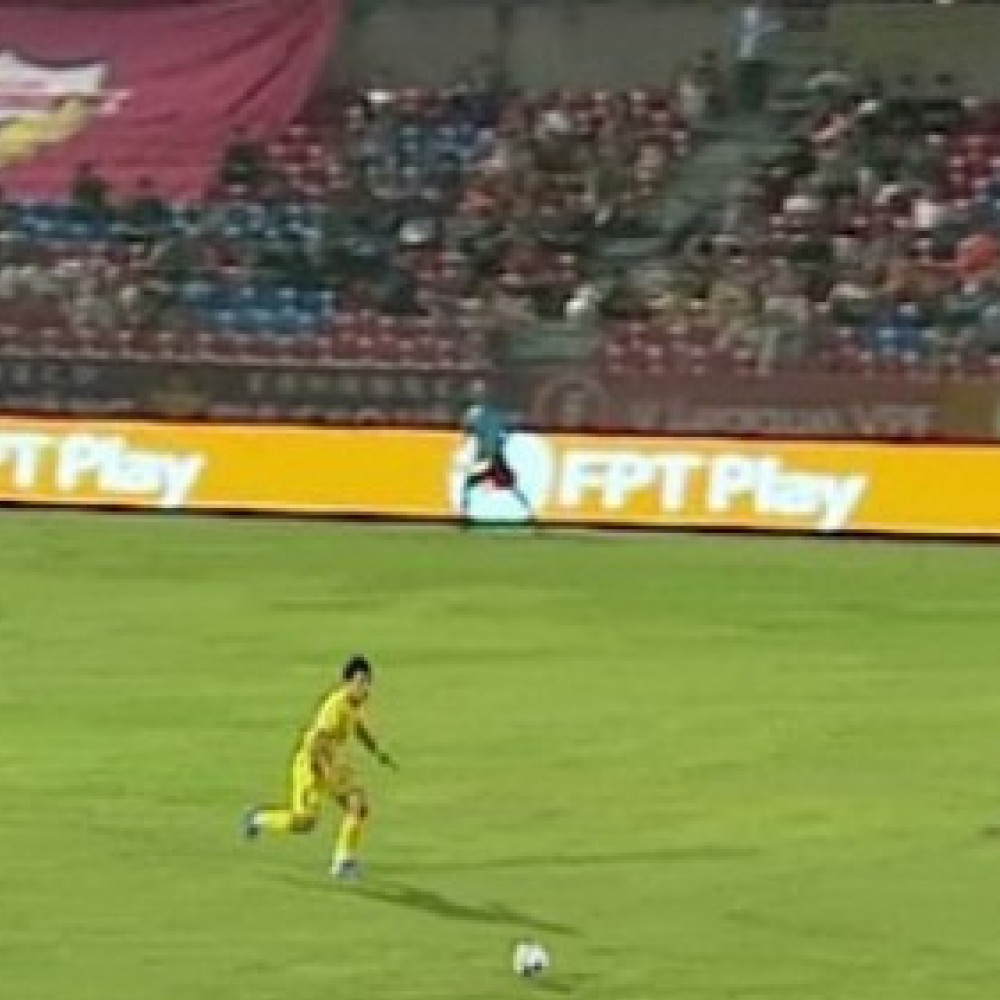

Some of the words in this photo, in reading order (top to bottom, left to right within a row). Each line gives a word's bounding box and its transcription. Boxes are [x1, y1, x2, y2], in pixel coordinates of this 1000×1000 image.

[57, 435, 206, 508] Play
[560, 453, 702, 510] FPT
[708, 456, 866, 531] Play
